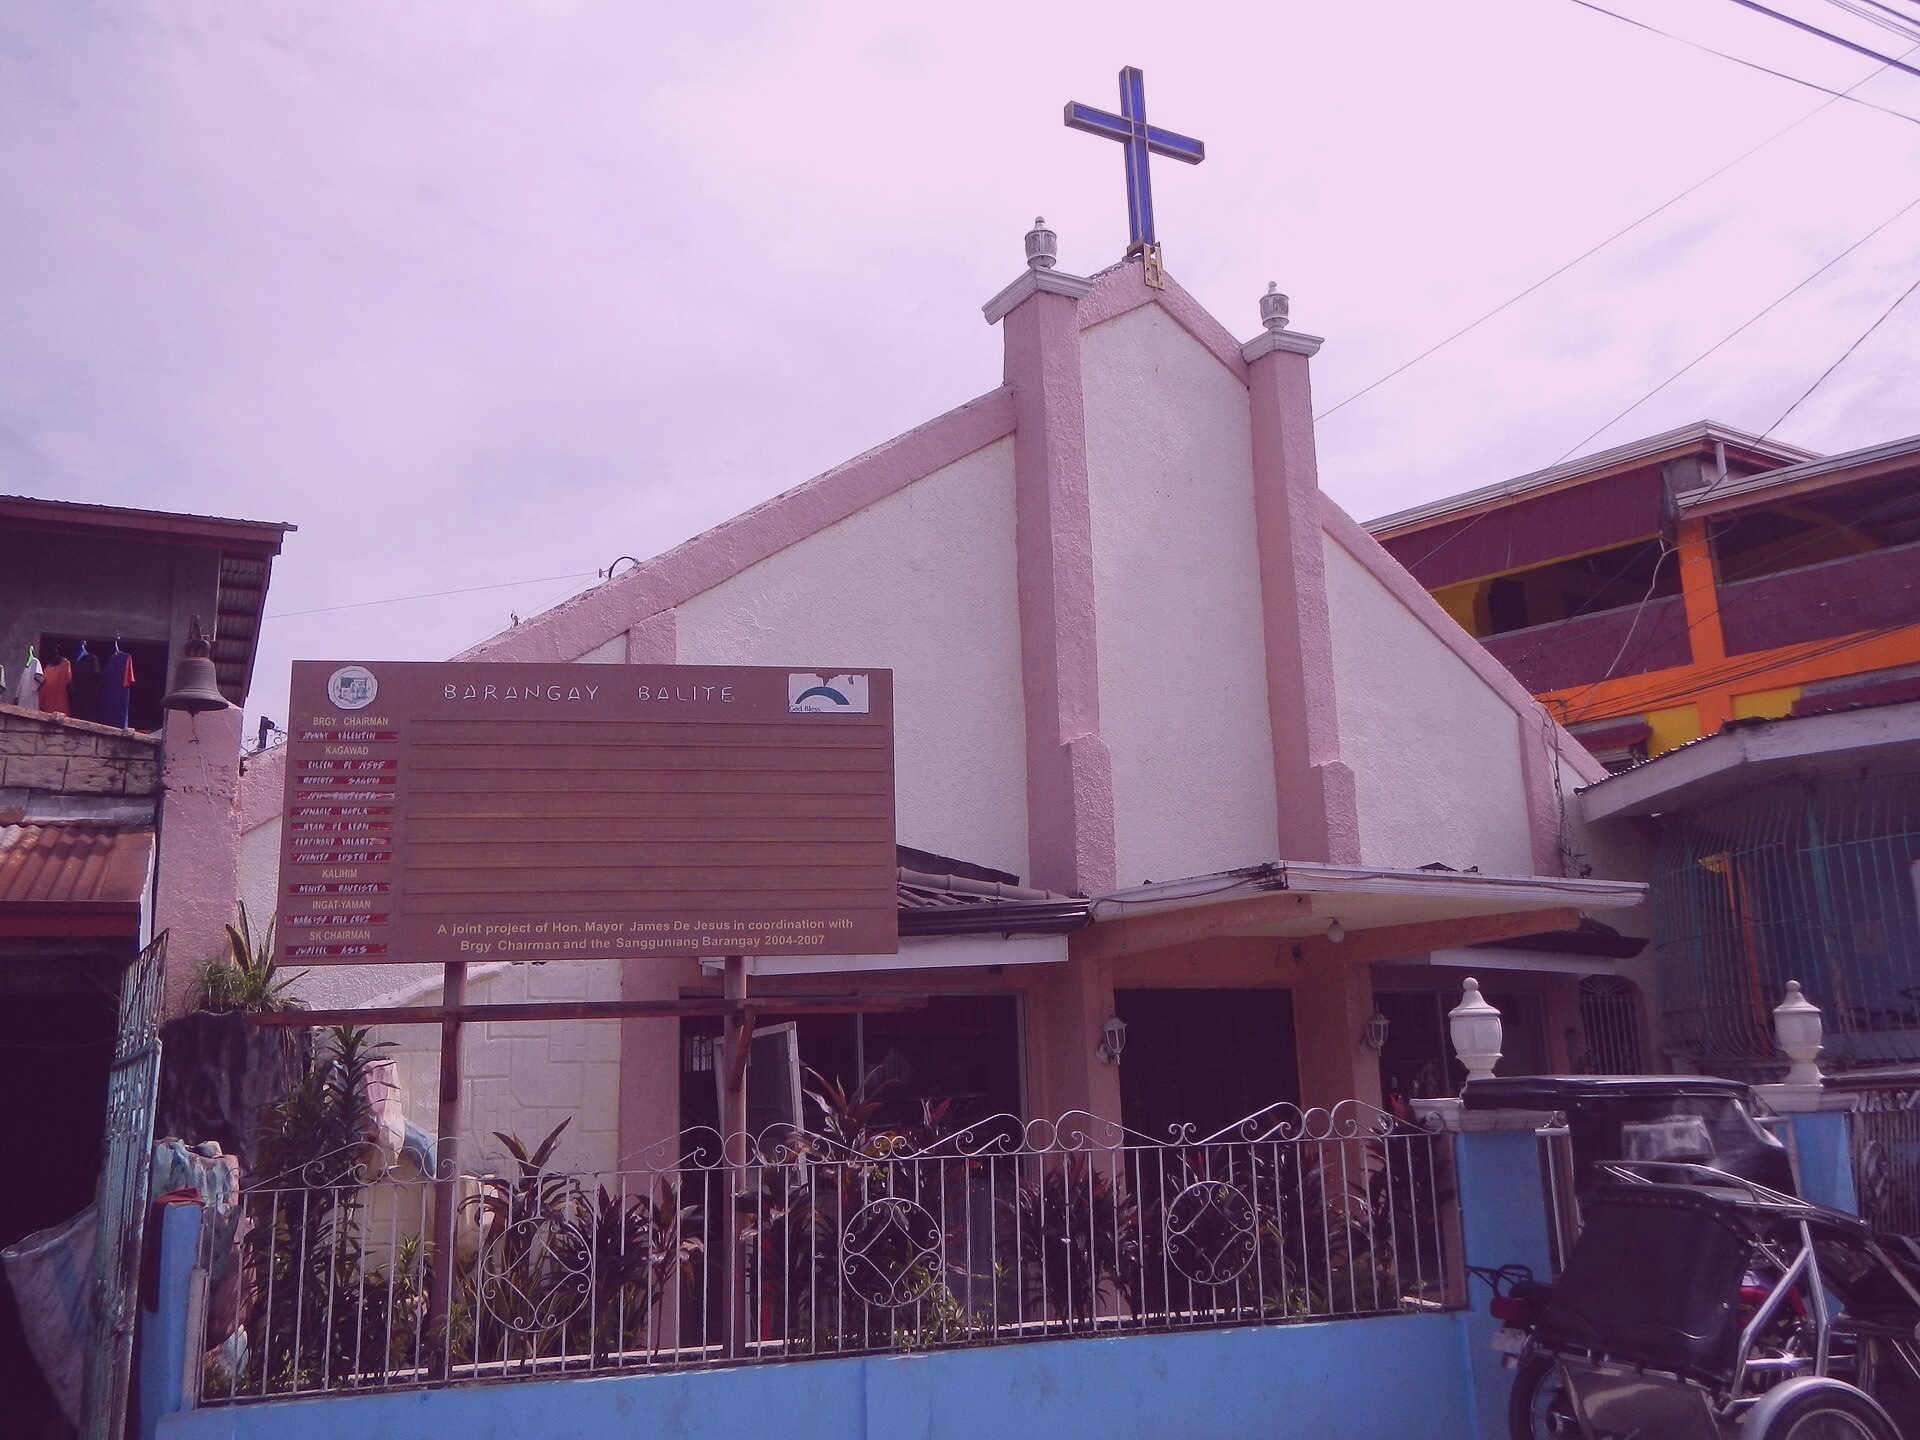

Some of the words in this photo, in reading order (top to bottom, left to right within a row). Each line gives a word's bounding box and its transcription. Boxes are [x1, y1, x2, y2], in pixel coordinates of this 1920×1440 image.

[444, 684, 598, 701] BARANGAY
[638, 685, 733, 703] BALITE
[343, 717, 389, 726] CHAIRMAN
[325, 746, 369, 755] KAGAWAD
[322, 869, 358, 878] KALIHIM
[312, 900, 371, 909] INGAT-YAMAN
[437, 924, 447, 934] A
[452, 923, 482, 936] joint
[486, 923, 531, 936] project
[535, 922, 549, 933] of
[552, 922, 581, 932] Hon.
[585, 921, 624, 933] Mayor
[630, 921, 670, 932] James
[673, 920, 690, 931] De
[694, 920, 730, 931] Jesus
[733, 919, 745, 930] in
[748, 919, 825, 930] coordination
[828, 918, 853, 929] with
[309, 932, 322, 940] SK
[324, 931, 371, 940] CHAIRMAN
[460, 940, 492, 953] Brgy
[497, 939, 560, 951] Chairman
[563, 938, 587, 949] and
[590, 938, 611, 949] the
[616, 937, 699, 949] Sangguniang
[702, 936, 760, 948] Barangay
[764, 935, 825, 946] 2004-2007
